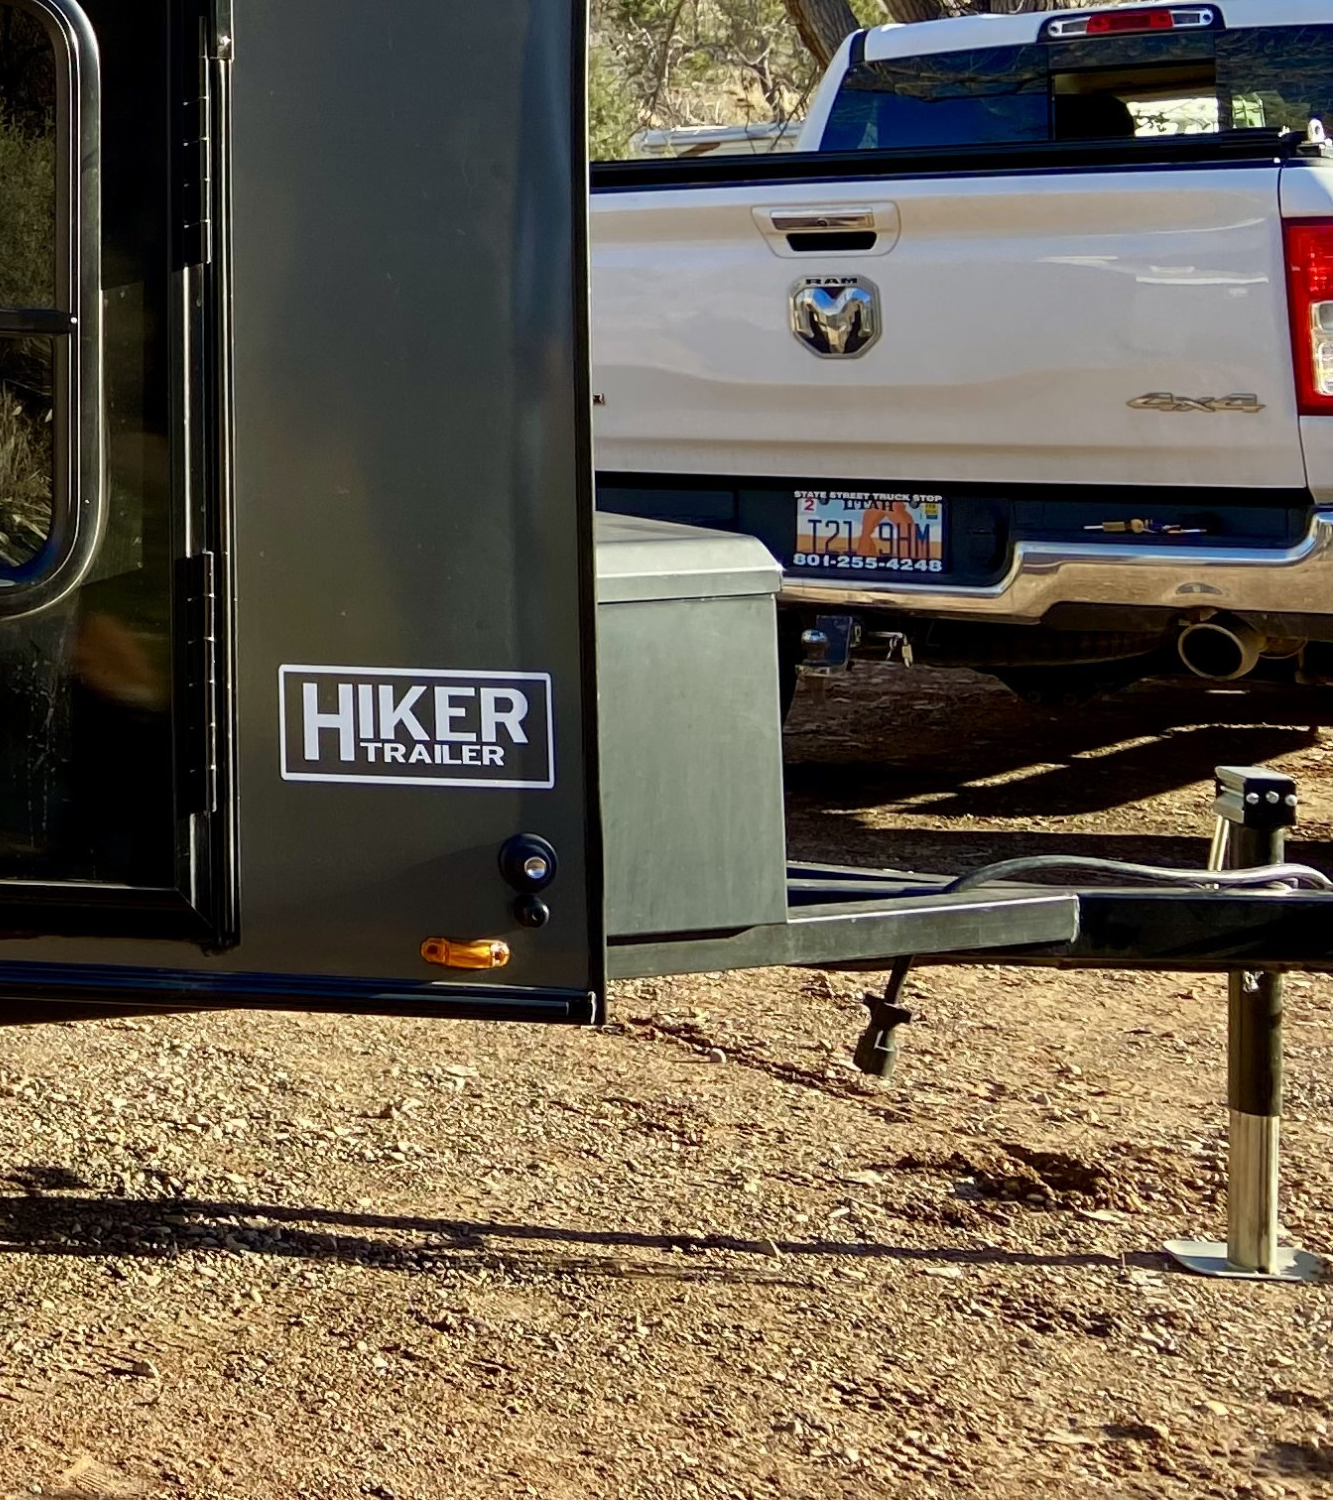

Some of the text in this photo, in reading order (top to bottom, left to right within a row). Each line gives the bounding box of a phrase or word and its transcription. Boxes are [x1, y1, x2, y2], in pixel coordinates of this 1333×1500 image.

[806, 277, 858, 285] RAM
[794, 490, 942, 503] STATE STREET TRUCK STOP
[804, 498, 815, 511] 2
[793, 553, 943, 573] 801-255-4248
[302, 682, 529, 761] HIKER
[359, 741, 505, 766] TRAILER
